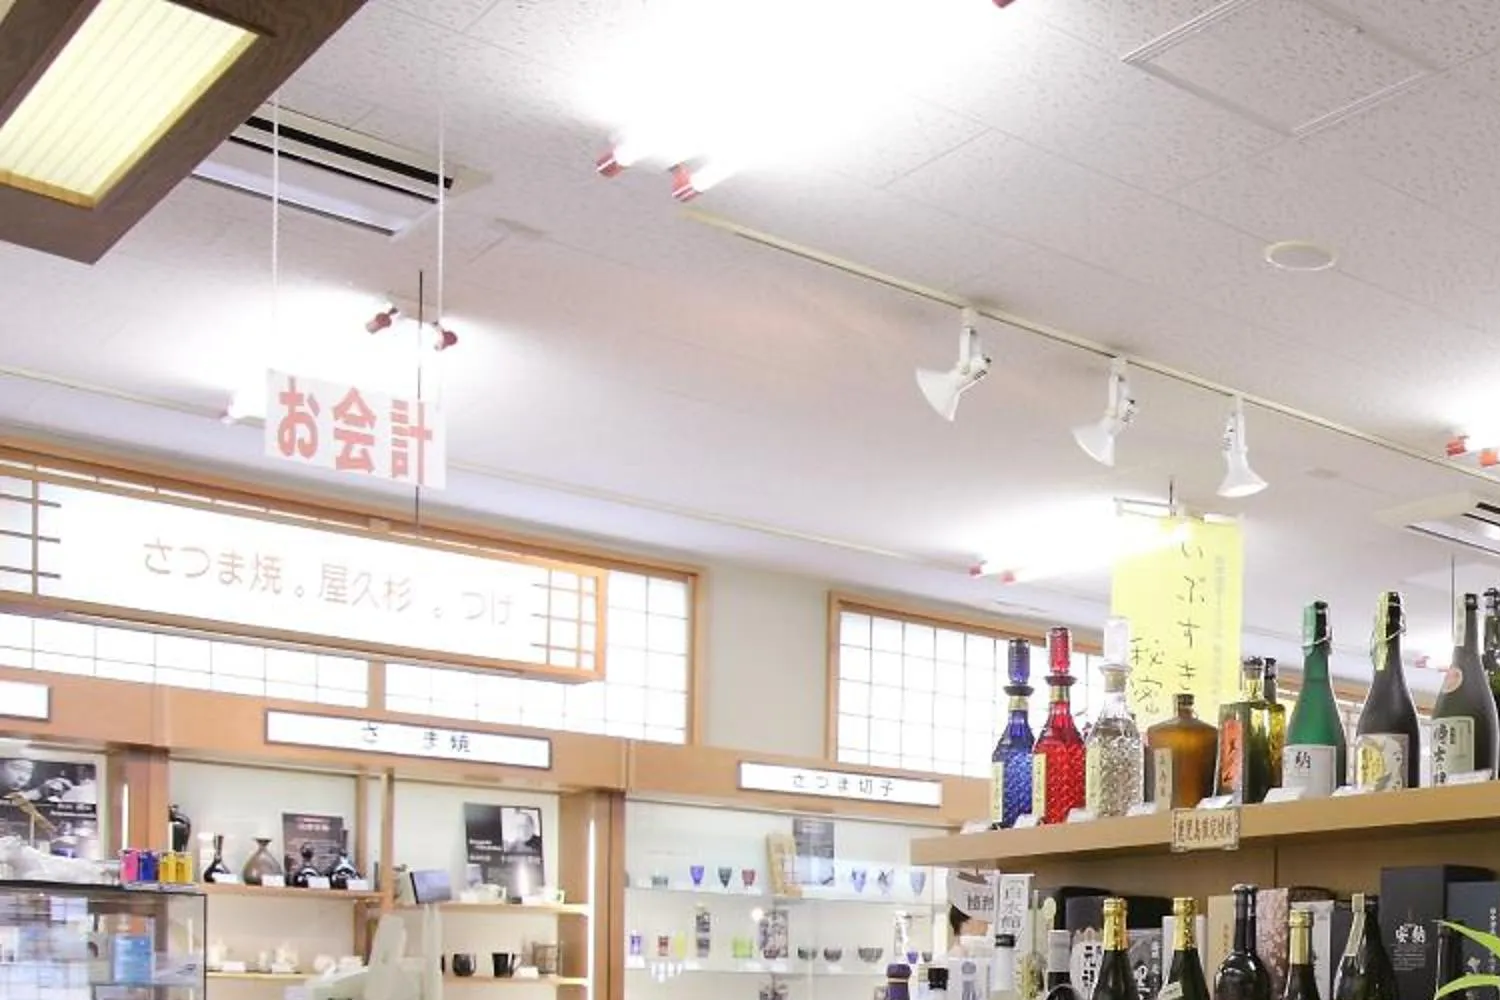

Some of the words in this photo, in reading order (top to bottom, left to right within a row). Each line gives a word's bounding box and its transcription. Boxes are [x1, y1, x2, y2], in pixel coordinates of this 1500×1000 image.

[277, 376, 433, 481] お会計
[360, 722, 471, 753] さま焼
[792, 773, 896, 797] さつま切子
